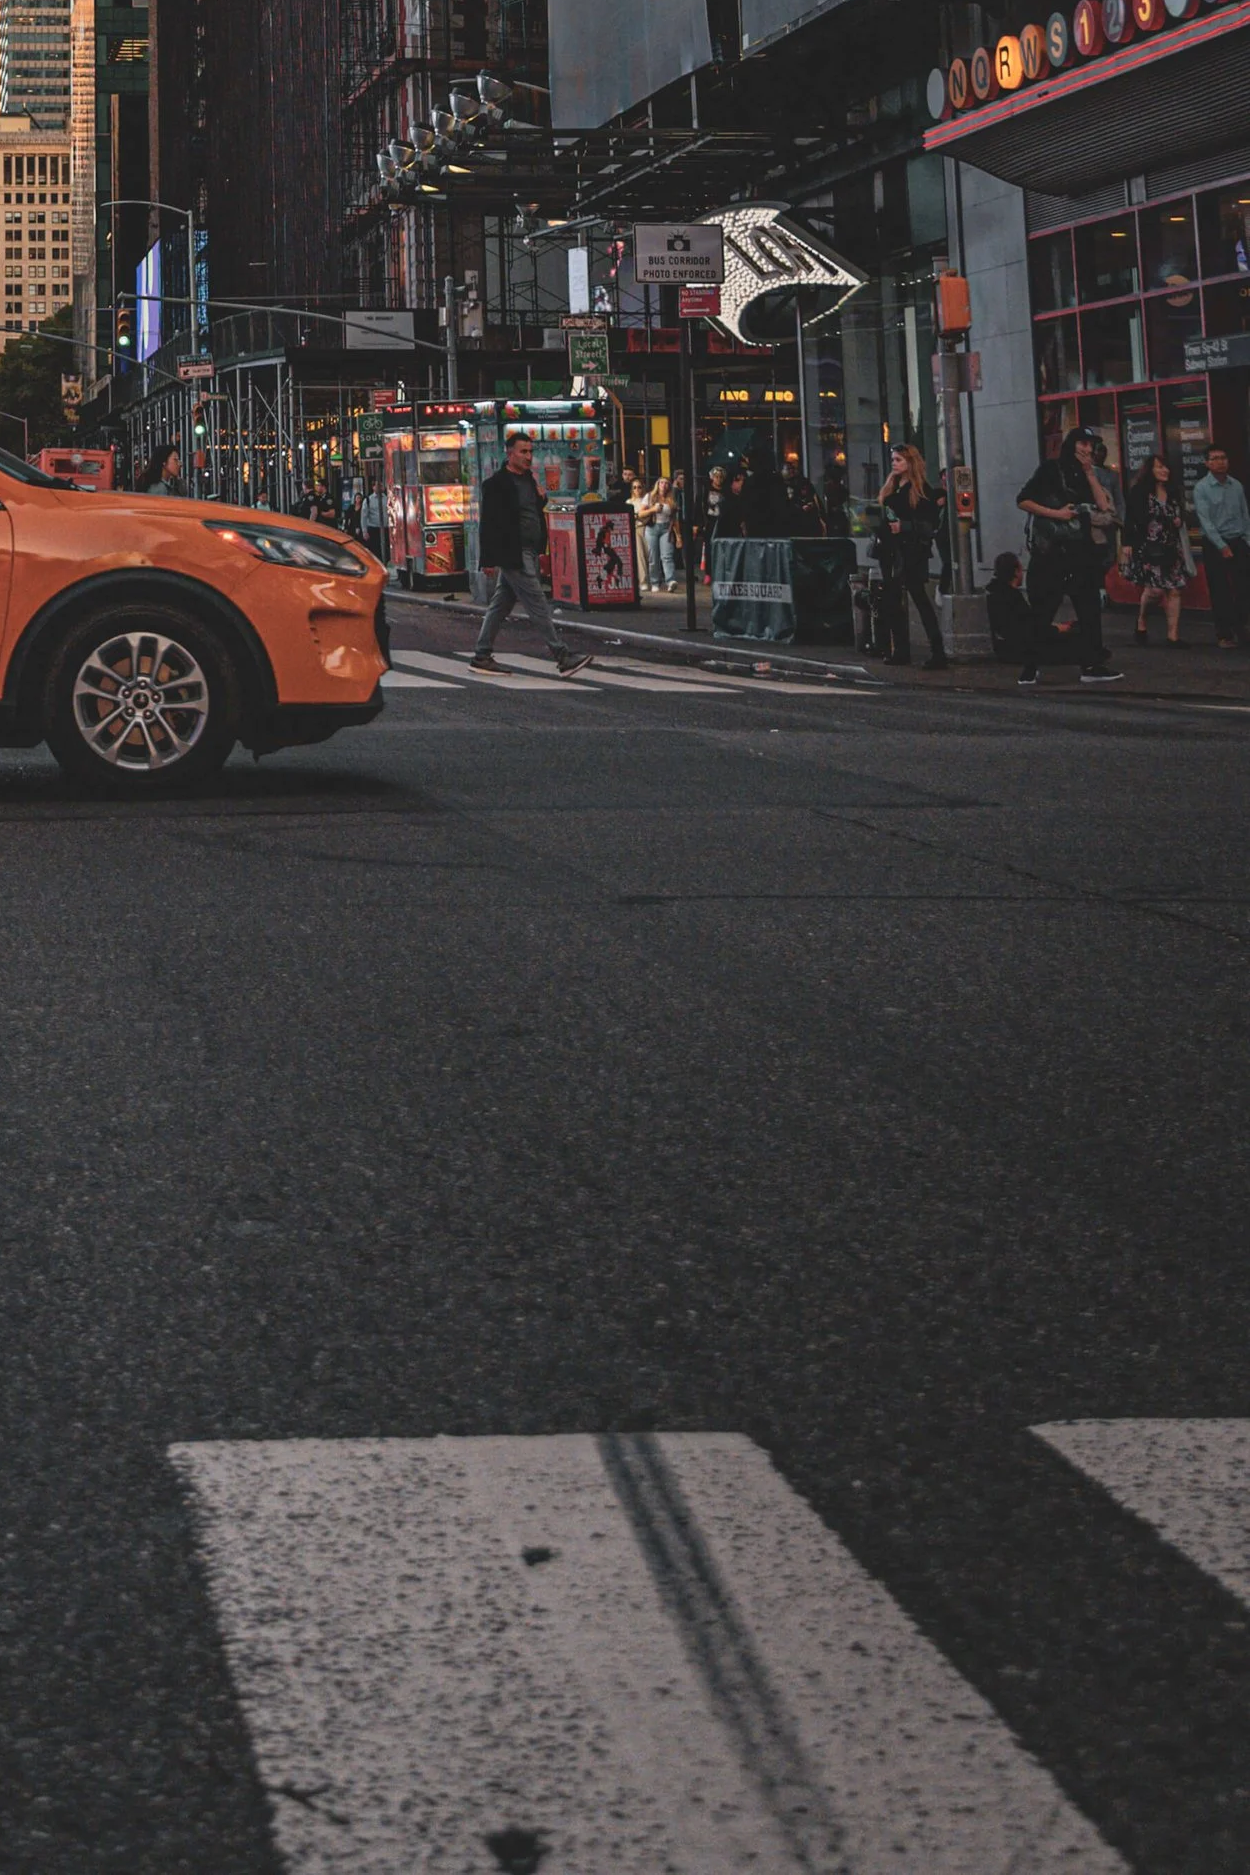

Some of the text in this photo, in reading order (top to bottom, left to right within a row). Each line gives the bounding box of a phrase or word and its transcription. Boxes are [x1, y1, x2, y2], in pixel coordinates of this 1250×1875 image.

[952, 72, 965, 102] N
[973, 55, 989, 86] Q
[998, 45, 1011, 80] R
[1019, 42, 1038, 72] W
[1050, 21, 1063, 58] S
[648, 256, 711, 266] BUS CORRIDOR
[643, 269, 717, 279] PHOTO ENFORCED
